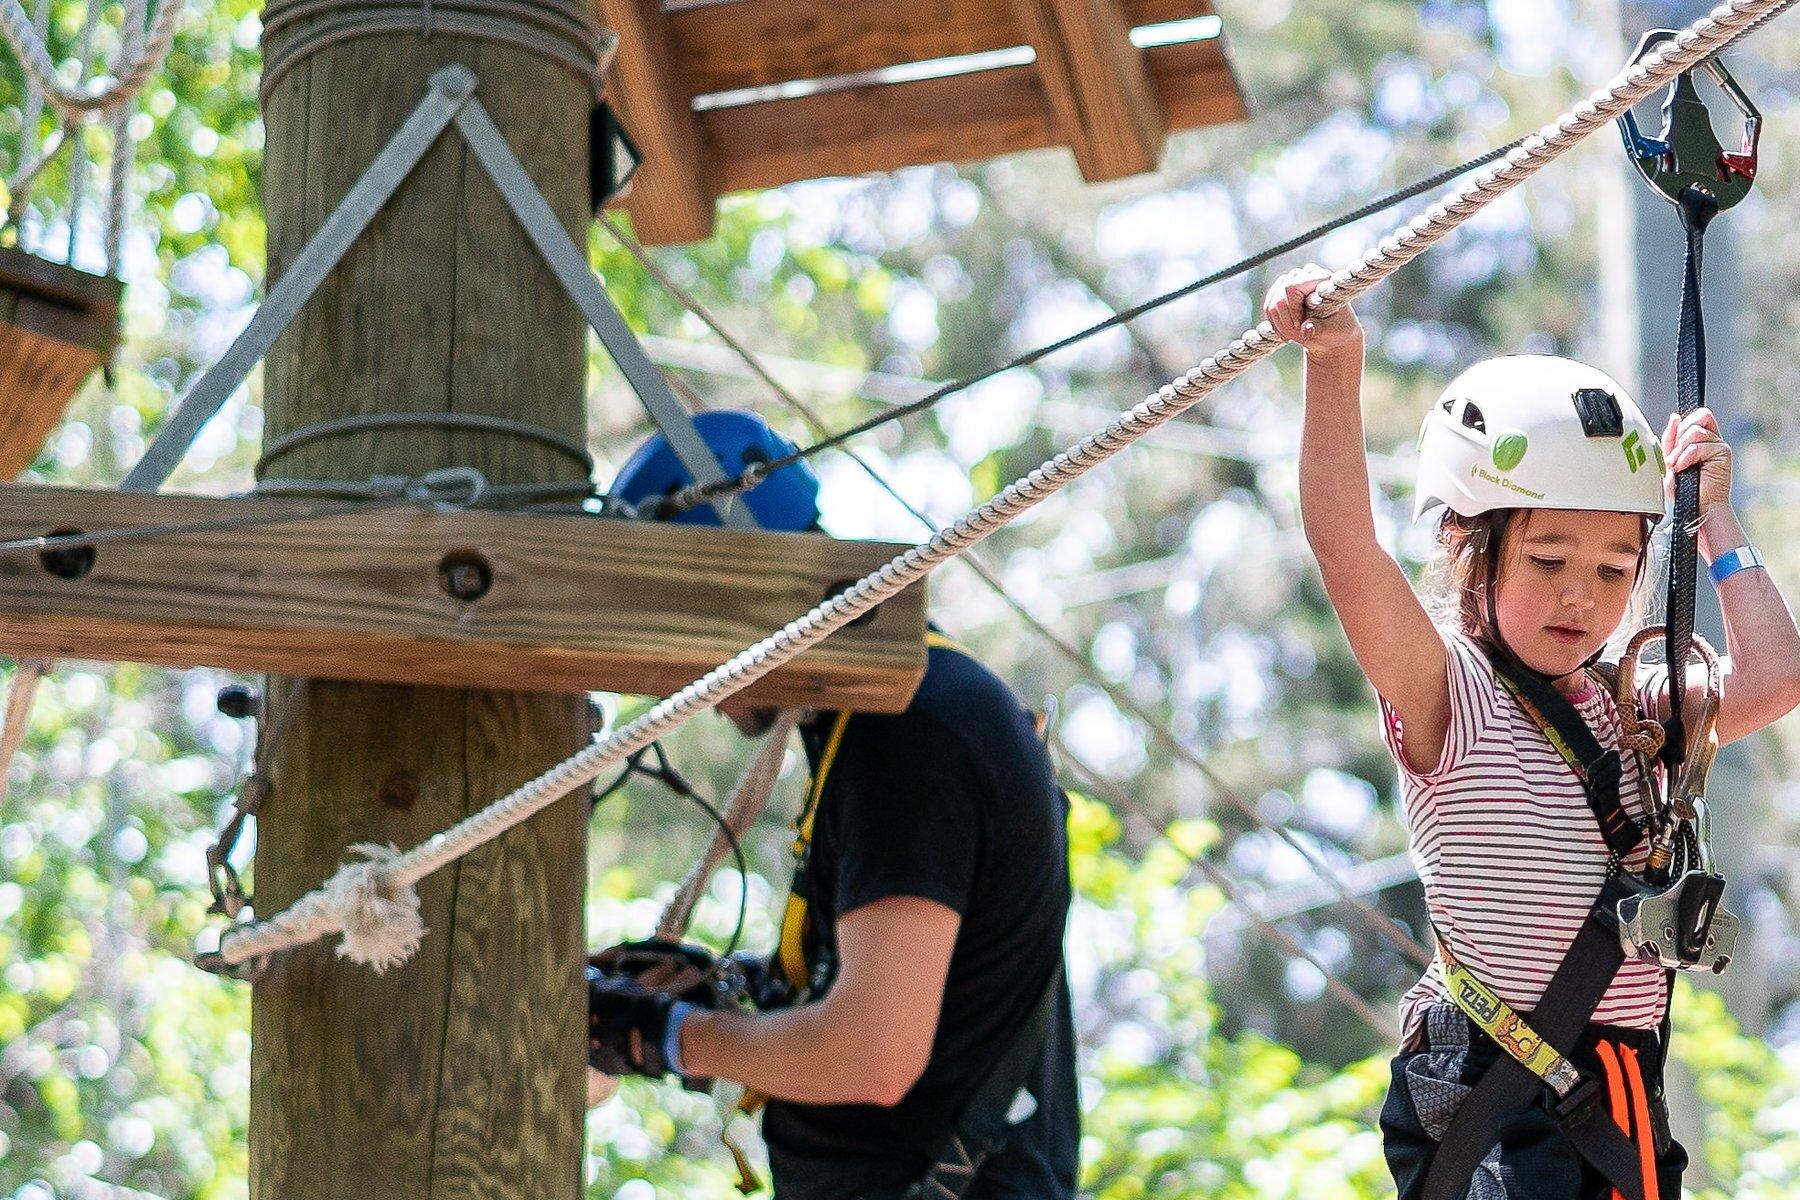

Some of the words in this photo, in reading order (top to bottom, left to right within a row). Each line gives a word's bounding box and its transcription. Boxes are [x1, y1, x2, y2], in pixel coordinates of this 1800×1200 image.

[1478, 468, 1501, 486] Black
[1502, 478, 1545, 500] Diamond
[1459, 979, 1501, 1022] PETZL
